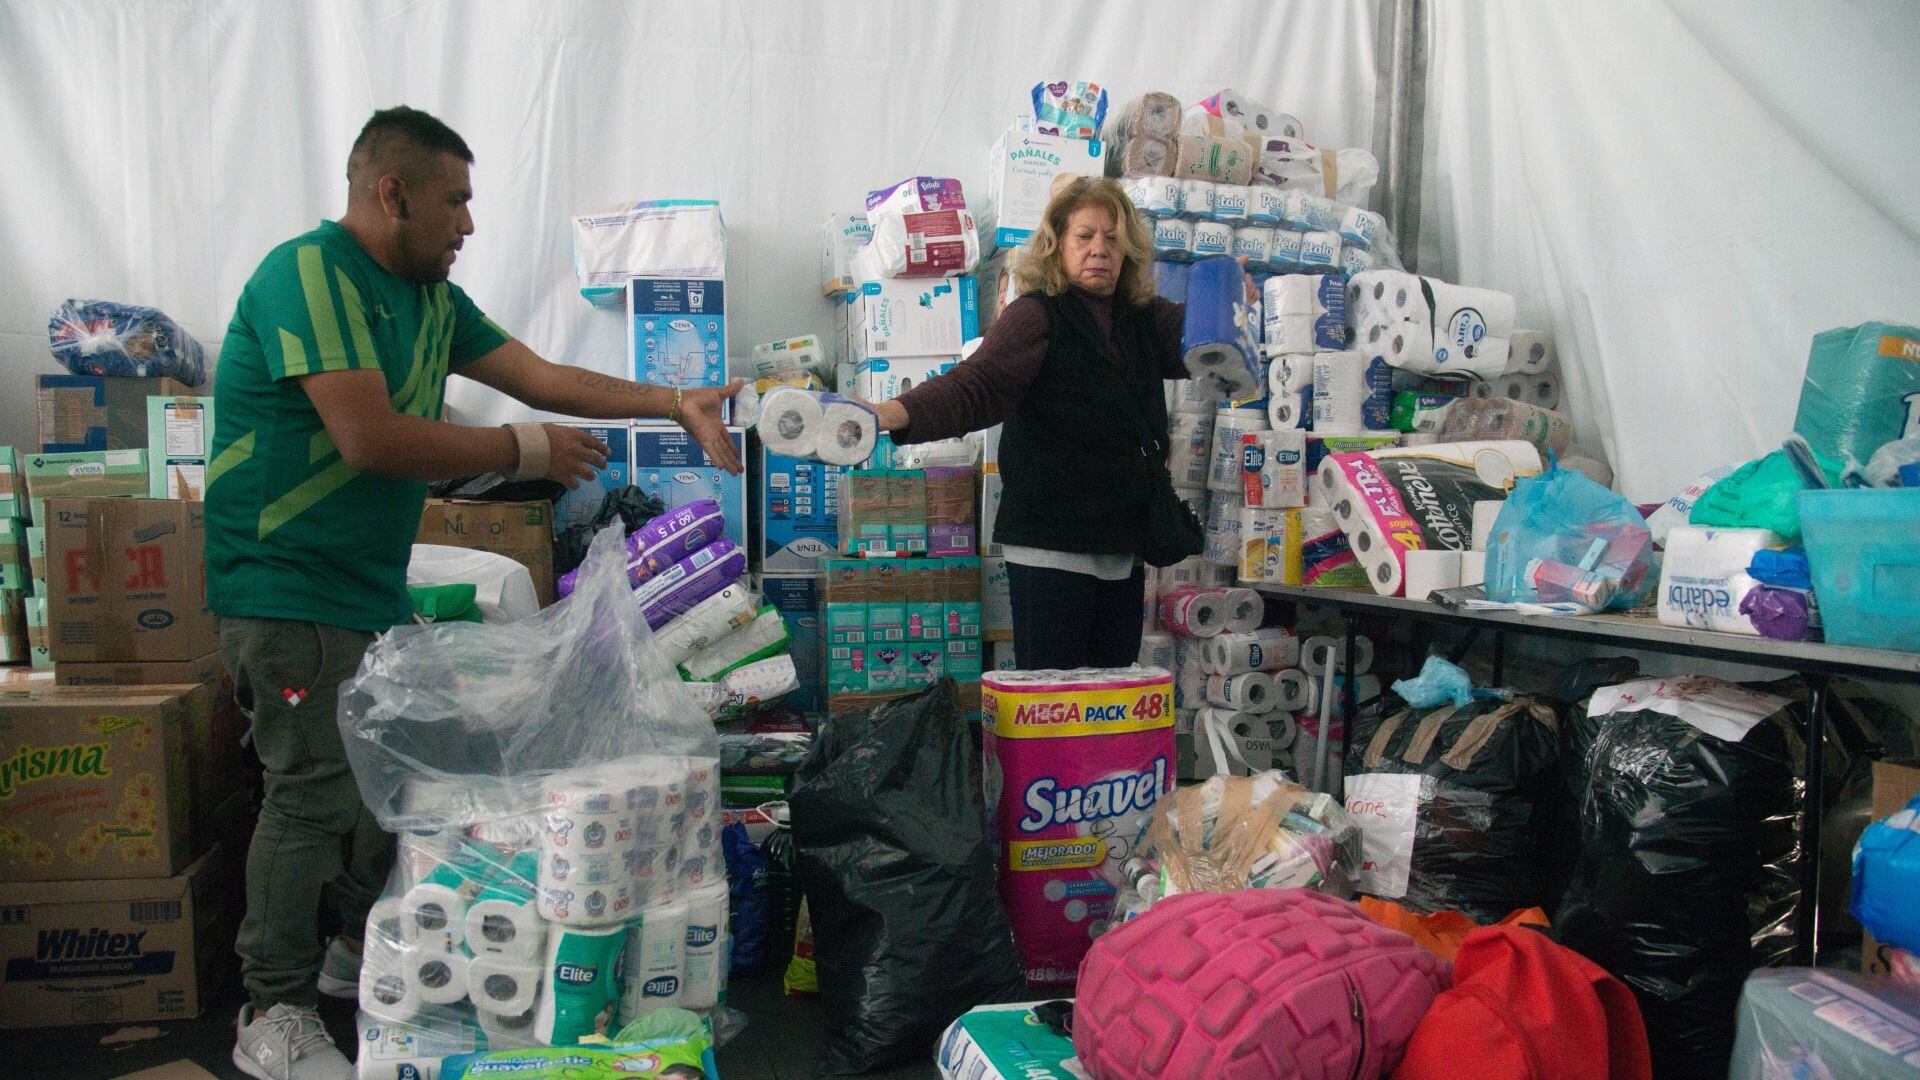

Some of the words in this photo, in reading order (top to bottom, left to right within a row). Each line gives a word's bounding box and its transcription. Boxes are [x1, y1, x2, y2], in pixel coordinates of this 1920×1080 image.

[1010, 147, 1062, 166] PAÑALES
[1156, 226, 1187, 241] étalo
[1303, 240, 1334, 257] étalo
[692, 296, 700, 304] 9
[1244, 449, 1264, 466] Elite
[1279, 453, 1300, 461] Elite
[74, 466, 101, 475] AVENA
[57, 511, 71, 523] 12
[797, 544, 823, 552] TENA
[1391, 529, 1424, 551] 4
[1668, 585, 1731, 611] edarbi
[881, 651, 897, 659] Saba
[918, 653, 934, 661] Saba
[1014, 701, 1081, 726] MEGA
[1085, 703, 1127, 723] PACK
[1132, 692, 1163, 721] 48
[1246, 737, 1271, 750] VASO
[1018, 757, 1167, 834] Suavel
[1022, 844, 1096, 861] ¡MEJORADO!
[686, 929, 714, 940] Elite
[37, 927, 148, 961] Whitex
[559, 966, 594, 983] Elite
[647, 977, 675, 993] Elite
